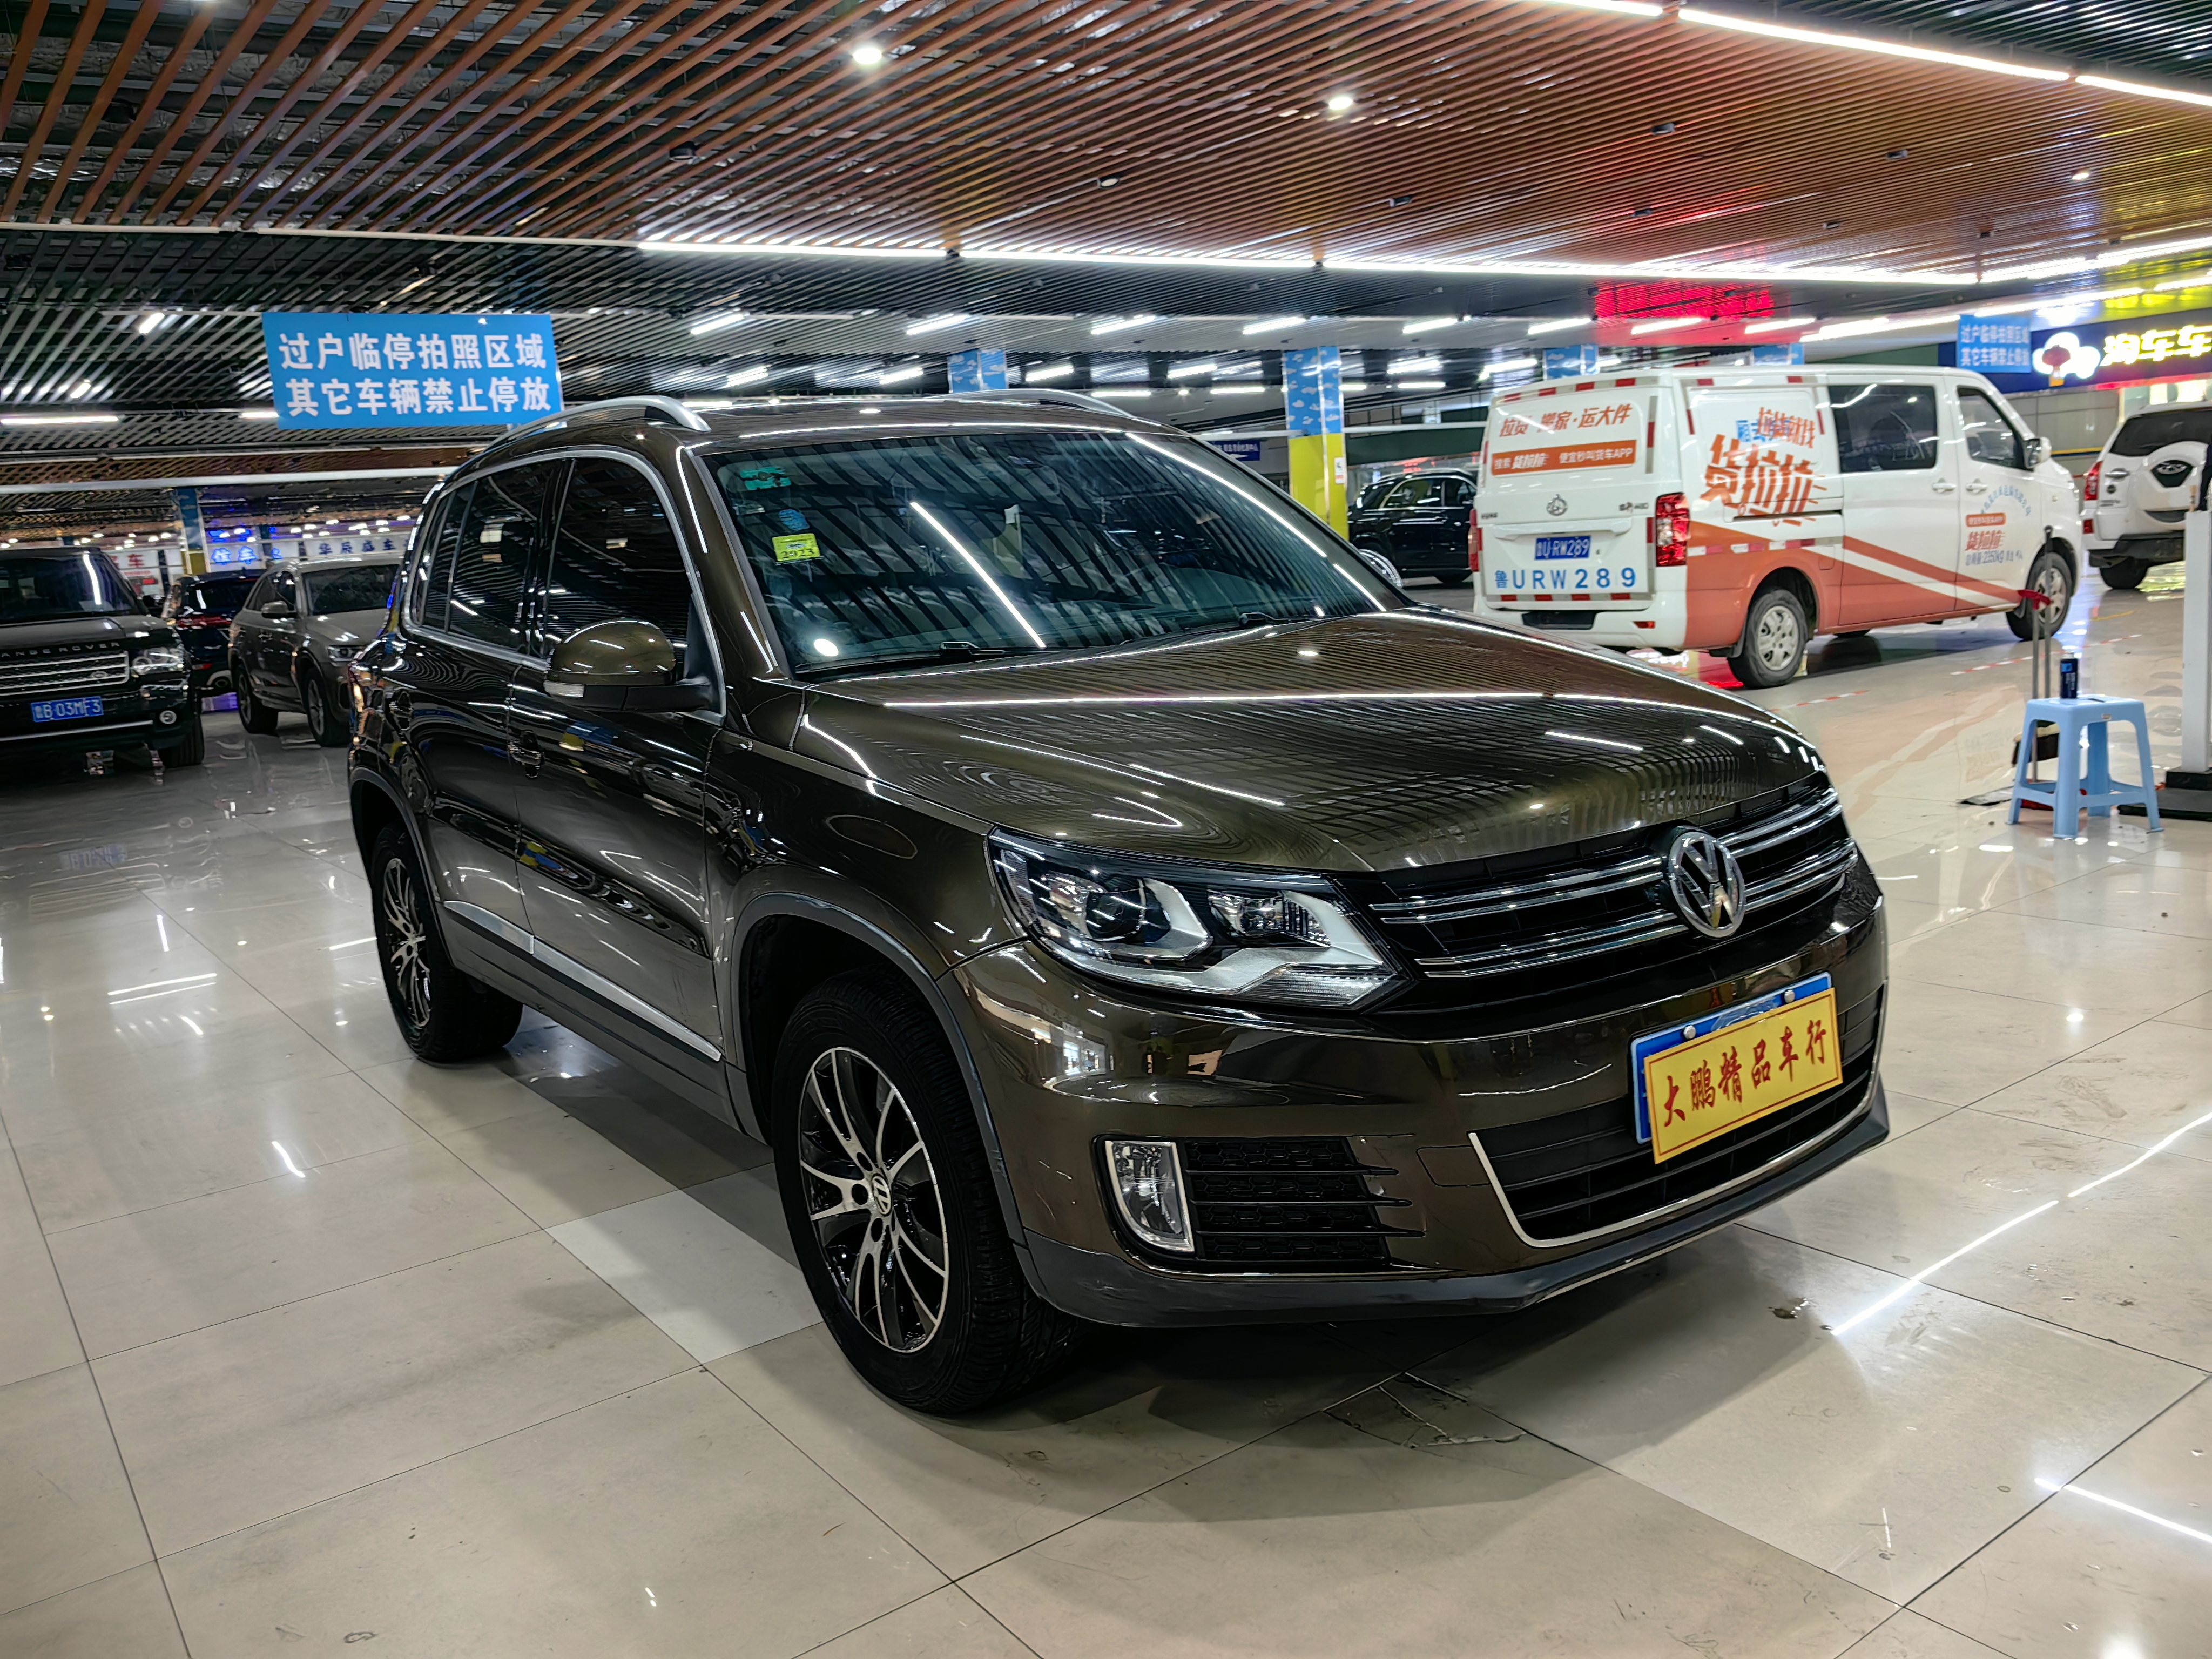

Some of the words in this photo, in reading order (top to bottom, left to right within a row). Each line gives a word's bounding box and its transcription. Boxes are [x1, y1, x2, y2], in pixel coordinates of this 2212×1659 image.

[279, 332, 547, 370] 过户临停拍照区域
[285, 376, 551, 417] 其它车辆禁止停放
[1700, 434, 1815, 527] 货拉拉
[780, 548, 814, 559] 2023
[1663, 1020, 1826, 1128] 大鹏精品车行
